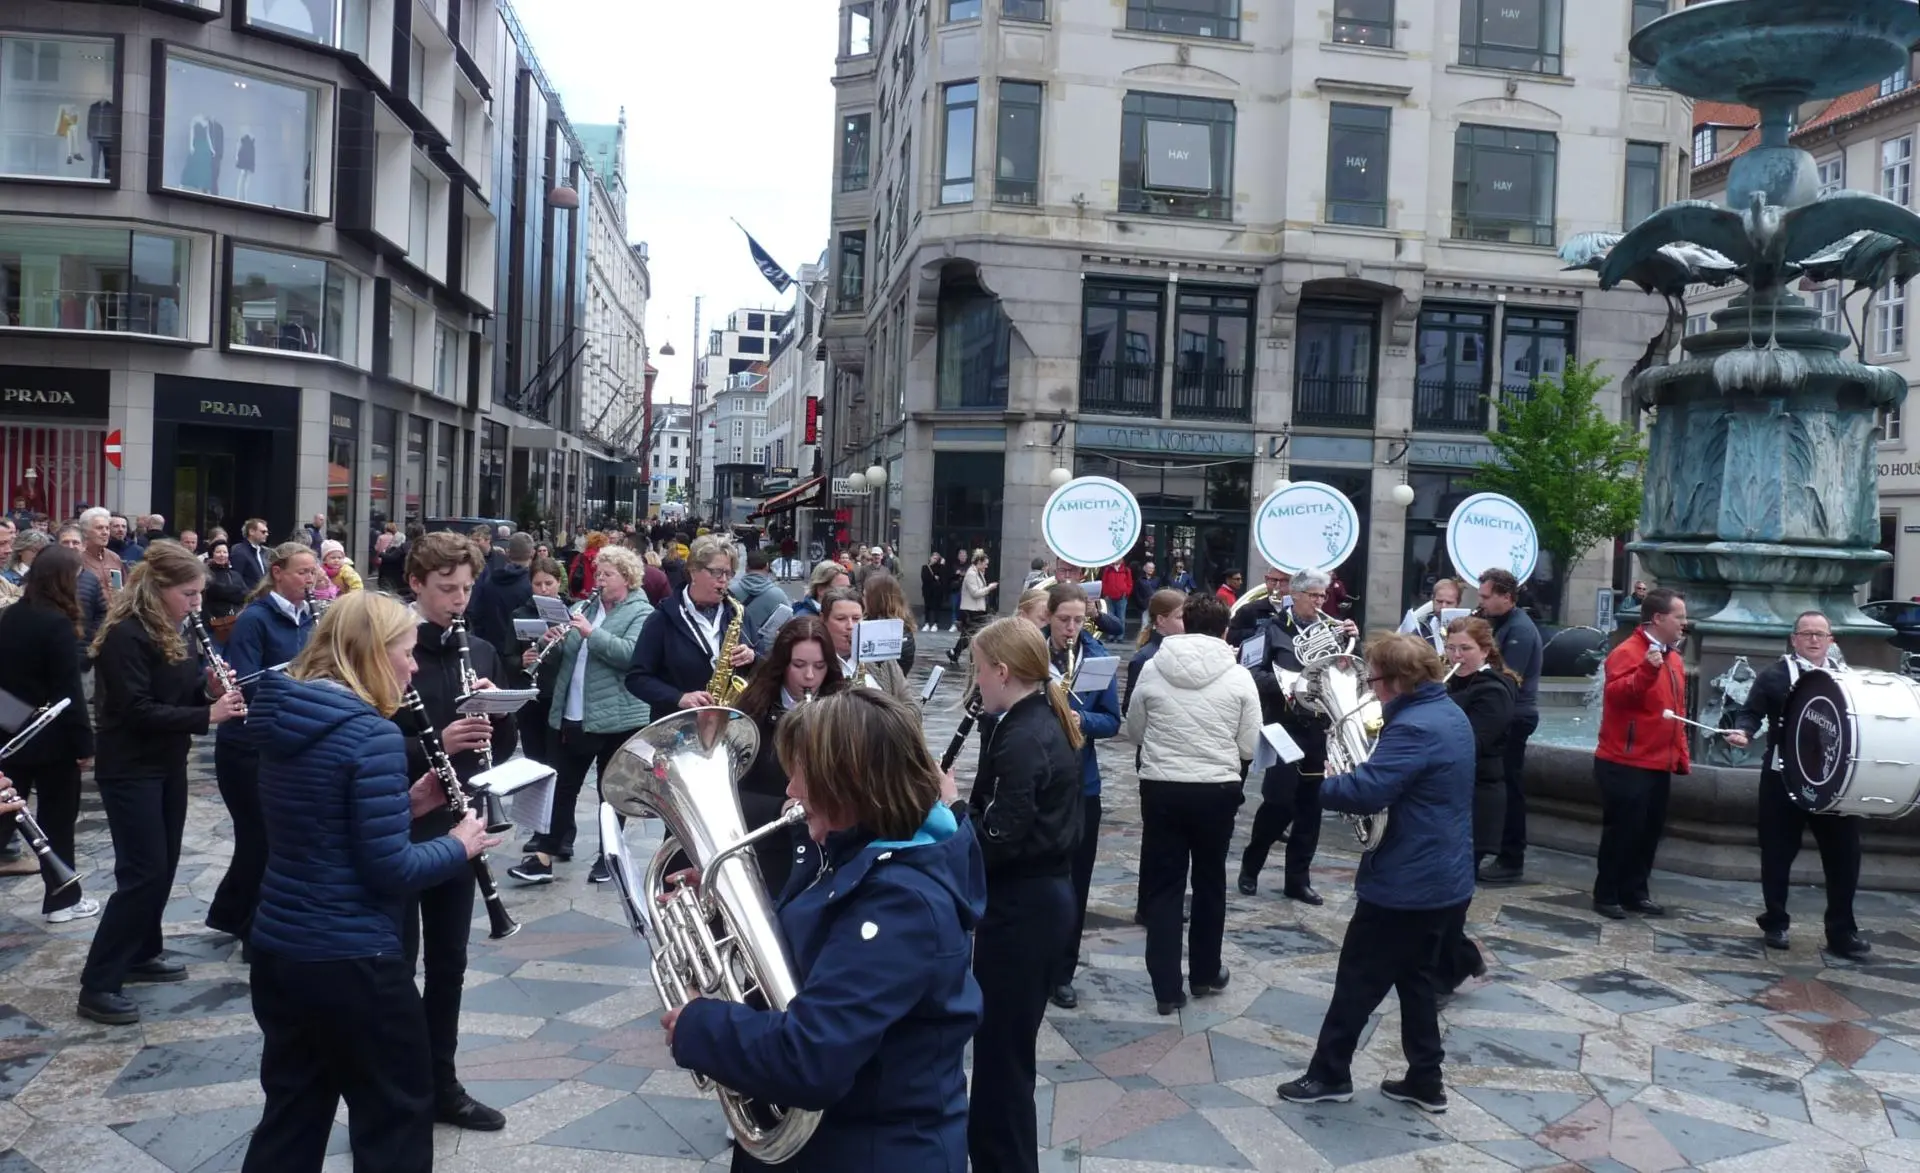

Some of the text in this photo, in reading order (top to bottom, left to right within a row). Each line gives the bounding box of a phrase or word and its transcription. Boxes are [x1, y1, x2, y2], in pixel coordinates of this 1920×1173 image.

[1501, 8, 1520, 19] HAY
[1168, 149, 1190, 160] HAY
[1346, 156, 1368, 168] HAY
[1493, 180, 1513, 191] HAY
[4, 388, 75, 404] PRADA
[200, 400, 263, 418] PRADA
[1056, 499, 1121, 512] AMICITIA
[1267, 503, 1334, 518] AMICITIA
[1463, 514, 1524, 533] AMICITIA
[1804, 709, 1837, 736] AMICITIA
